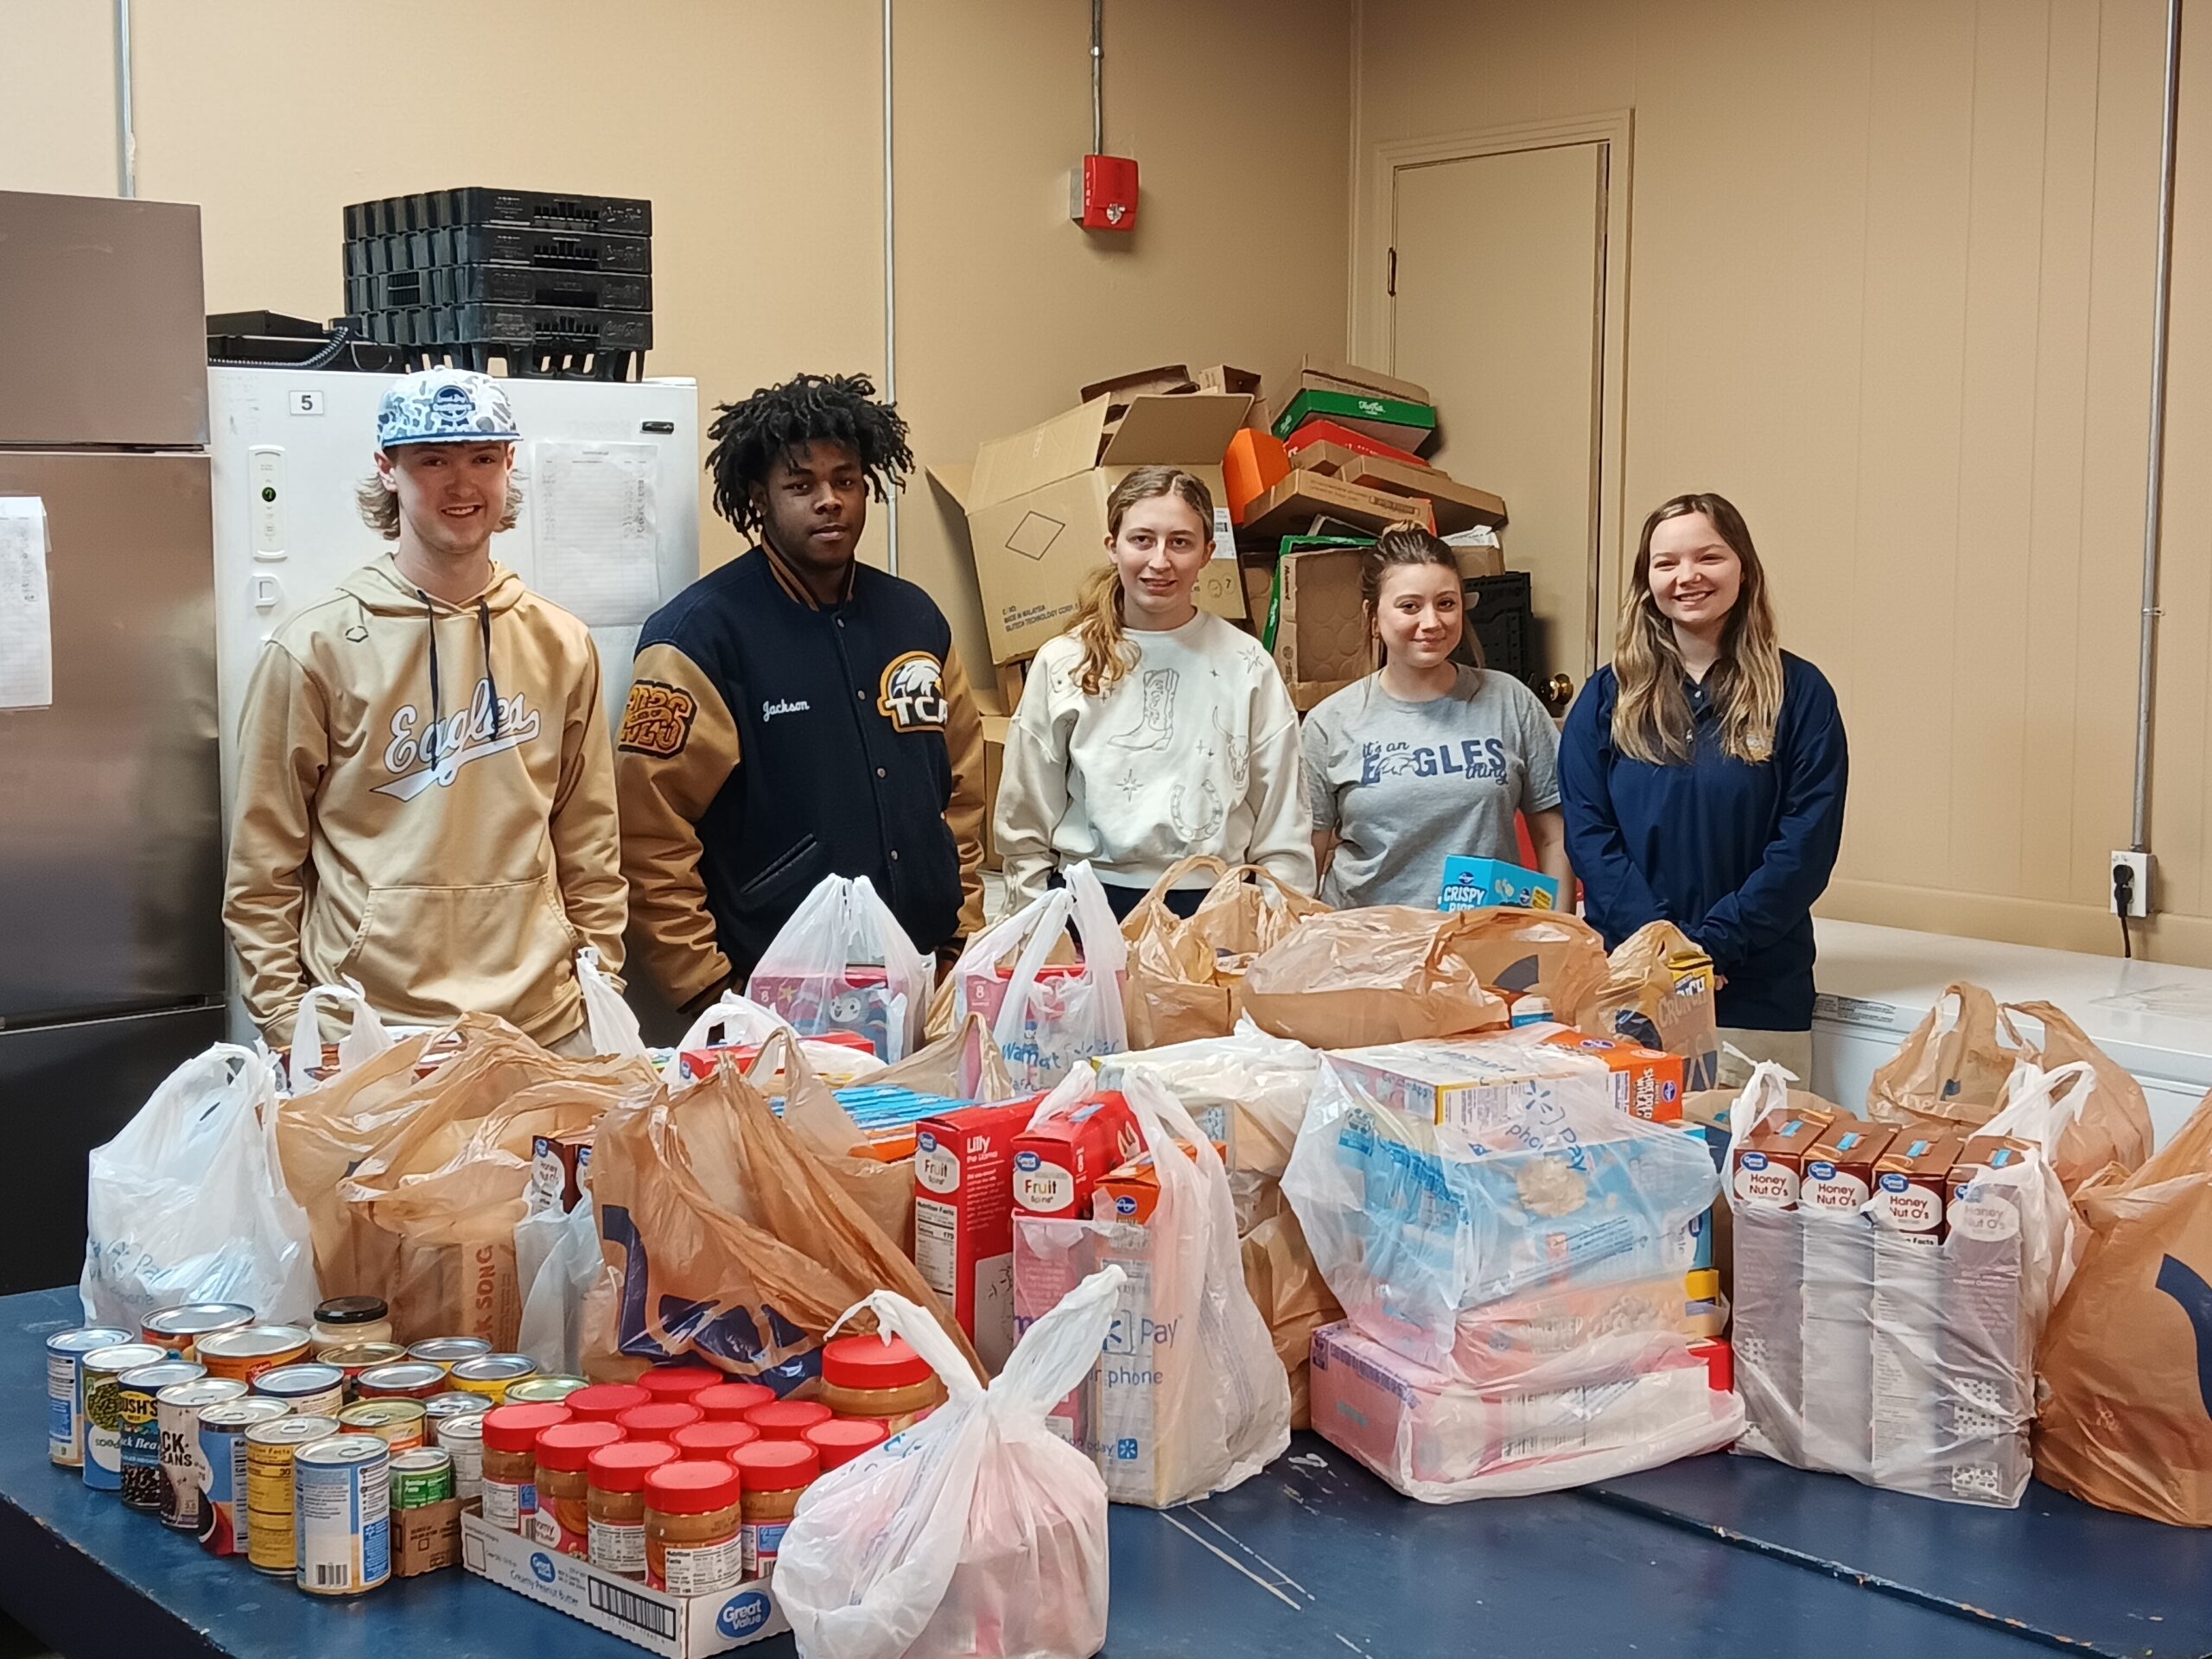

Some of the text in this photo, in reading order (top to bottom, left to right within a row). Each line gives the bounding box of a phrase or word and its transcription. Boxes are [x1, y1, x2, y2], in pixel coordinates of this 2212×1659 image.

[302, 395, 313, 410] 5
[763, 698, 810, 721] Jackson
[384, 677, 540, 788] Eagles
[1386, 741, 1410, 753] an
[1464, 762, 1509, 785] thing
[1444, 886, 1485, 906] CRISPY
[761, 990, 770, 1002] 8
[976, 985, 985, 999] 8
[966, 1135, 991, 1154] Lilly
[925, 1159, 948, 1178] Fruit
[1077, 1154, 1084, 1173] 8
[1025, 1179, 1057, 1194] Fruit
[1751, 1173, 1787, 1189] Honey
[1749, 1185, 1789, 1197] Nut O's
[1818, 1183, 1855, 1198] Honey
[1816, 1194, 1857, 1206] Nut O's
[1890, 1196, 1929, 1212] Honey
[1890, 1206, 1929, 1219] Nut O's
[1965, 1205, 2005, 1219] Honey
[1912, 1237, 1935, 1246] Facts
[475, 1244, 495, 1310] SONG
[1141, 1318, 1178, 1348] Pay
[1108, 1366, 1164, 1389] phone
[121, 1397, 158, 1418] USH'S
[135, 1438, 160, 1451] Bea
[1086, 1441, 1115, 1457] oday
[722, 1599, 762, 1624] Great
[732, 1613, 762, 1630] Value
